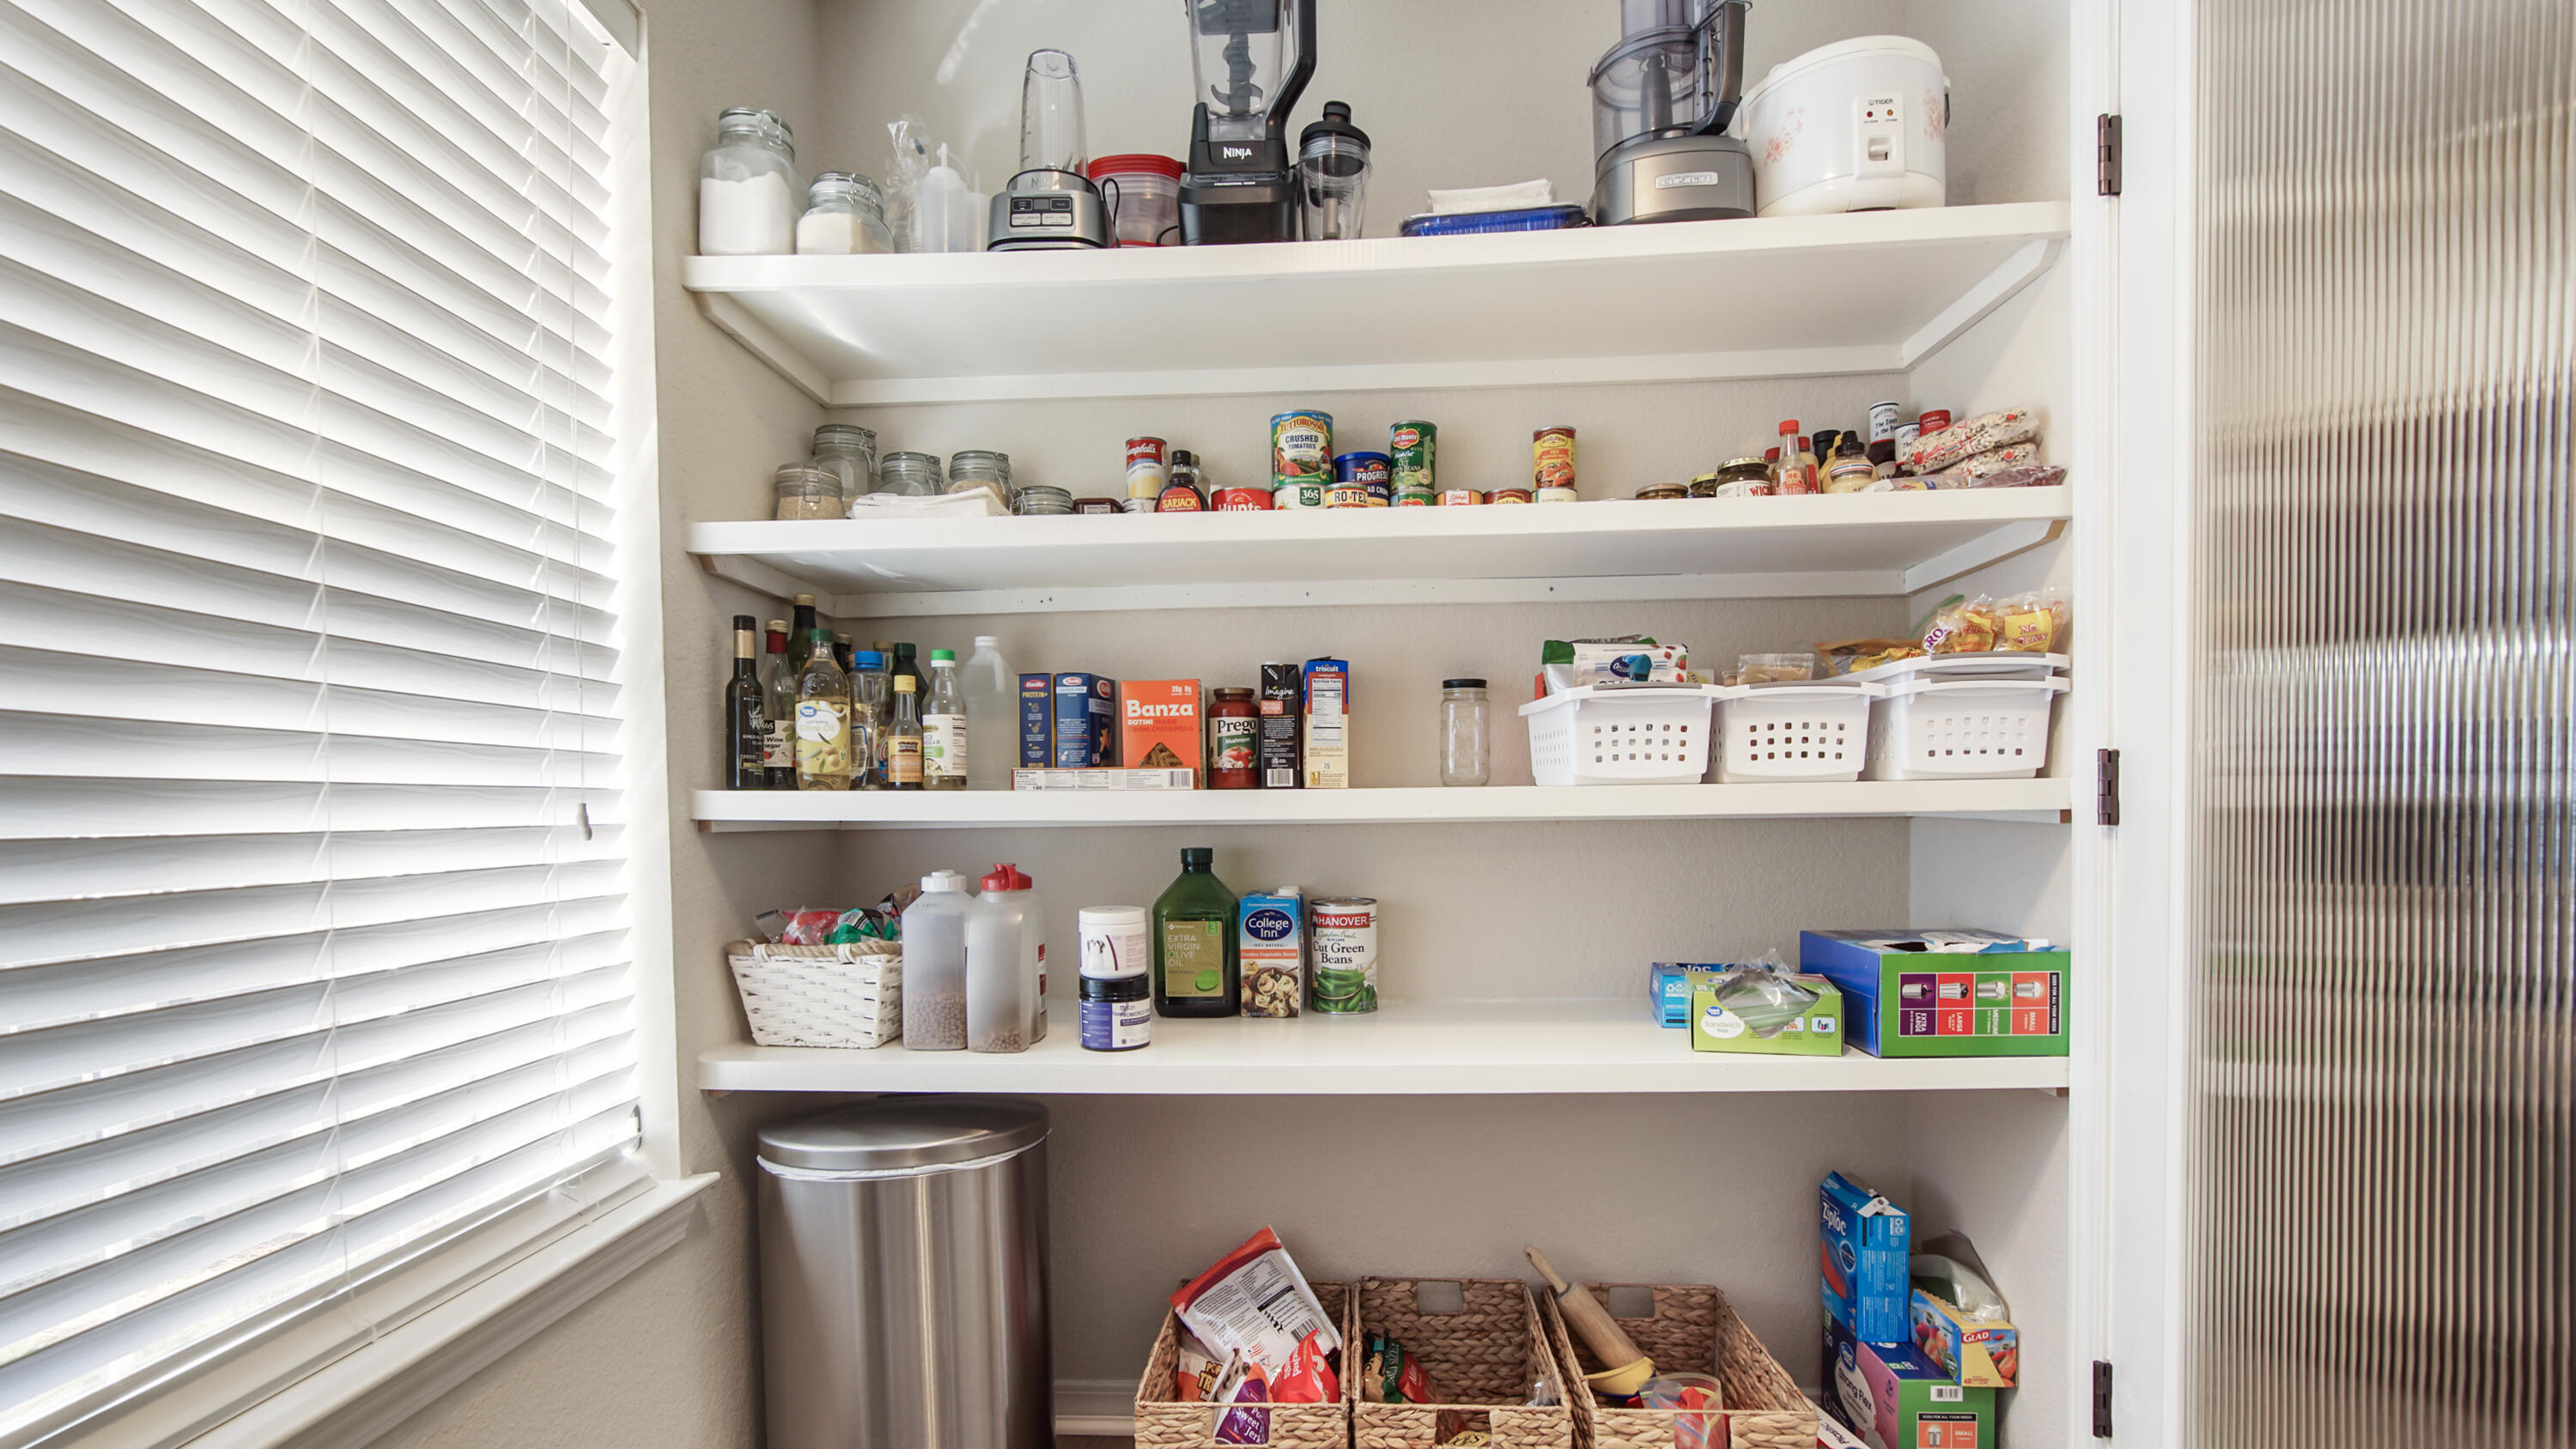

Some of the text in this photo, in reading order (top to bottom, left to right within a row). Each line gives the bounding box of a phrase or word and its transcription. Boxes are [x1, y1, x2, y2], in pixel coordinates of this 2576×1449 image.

[1223, 146, 1253, 160] NINJA
[1280, 418, 1325, 432] TUTTOROSSO
[1285, 434, 1320, 444] CRUSHED
[1301, 489, 1320, 500] 365
[2020, 623, 2040, 634] NO
[1315, 664, 1340, 673] triscuit
[1265, 685, 1295, 700] Imagine
[1126, 699, 1194, 718] Banza
[1217, 719, 1257, 736] Prego
[1249, 917, 1290, 931] College
[1318, 916, 1368, 926] HANOVER
[1168, 934, 1197, 943] EXTRA
[1261, 928, 1279, 937] Inn
[1168, 943, 1200, 951] VIRGIN
[1313, 941, 1365, 954] Cut Green
[1168, 950, 1195, 959] OLIVE
[1321, 953, 1353, 964] Beans
[1168, 959, 1184, 967] OIL
[1821, 1201, 1846, 1236] Ziploc
[1963, 1331, 1990, 1343] GLAD
[1858, 1387, 1873, 1413] Flex
[1236, 1406, 1260, 1430] Sweet
[1244, 1426, 1262, 1445] Jerk
